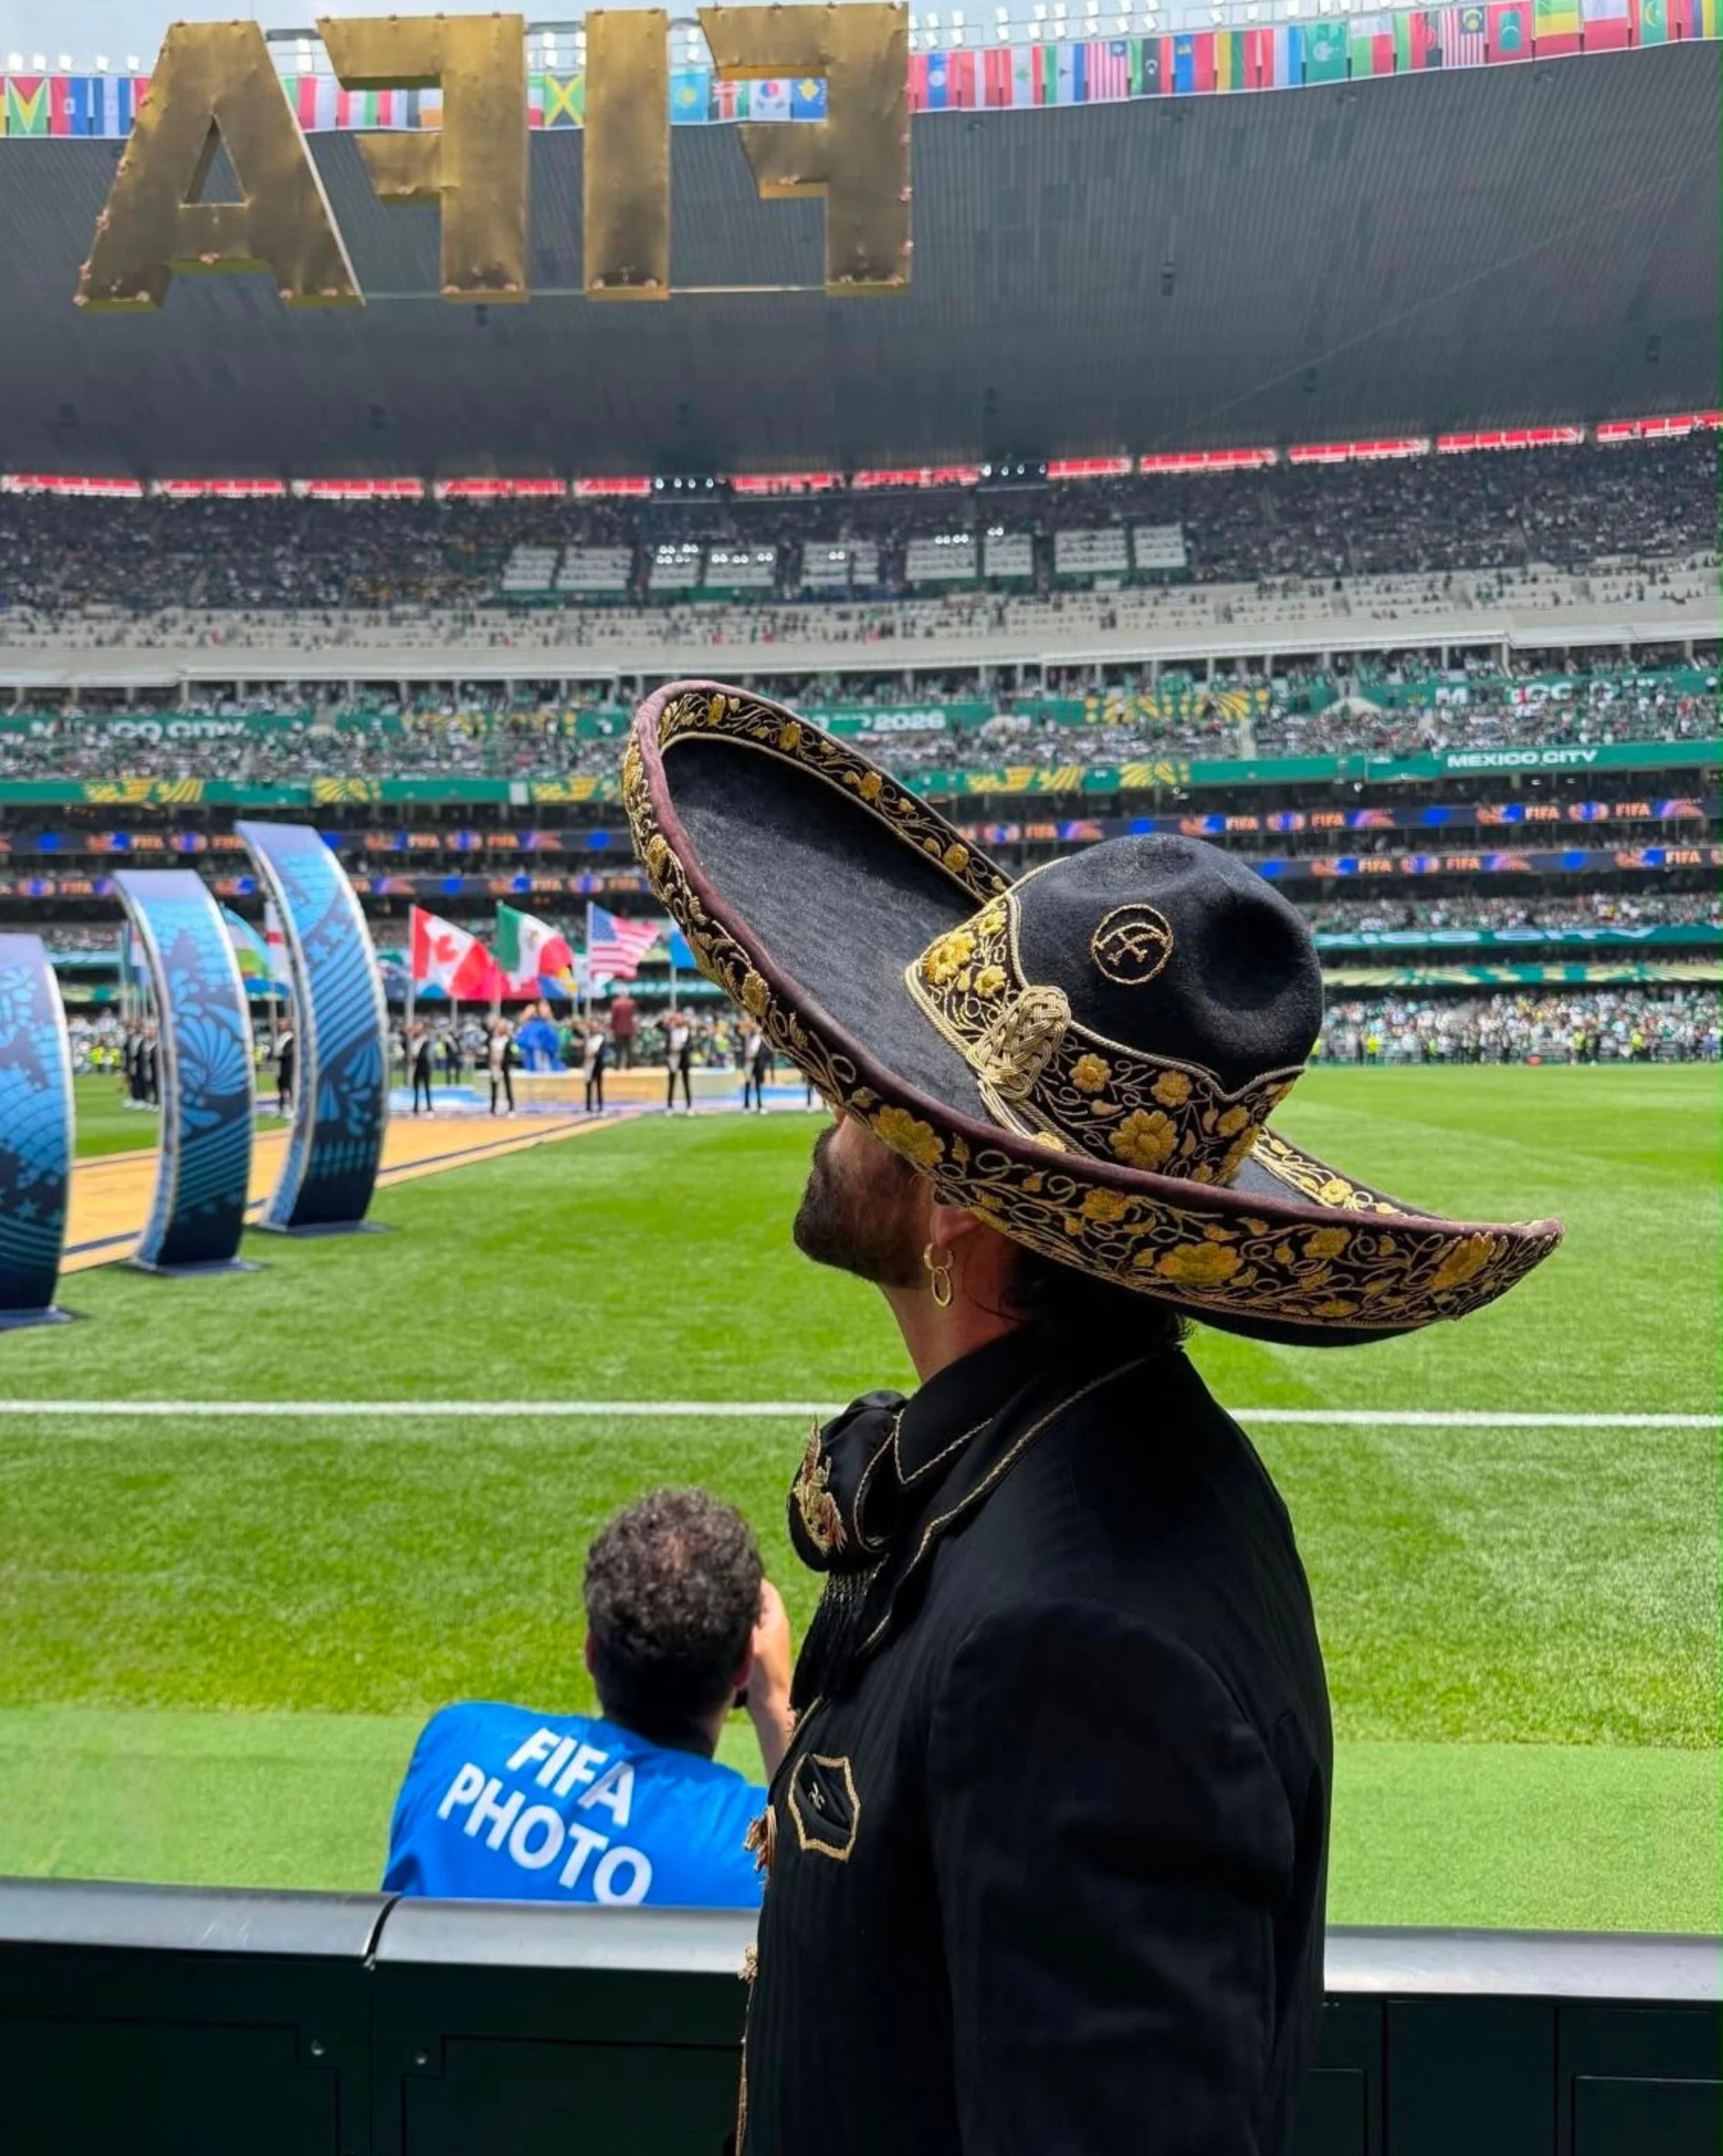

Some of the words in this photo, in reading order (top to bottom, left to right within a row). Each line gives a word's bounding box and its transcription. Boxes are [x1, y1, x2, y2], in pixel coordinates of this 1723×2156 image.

[873, 709, 946, 731] 2026
[1448, 751, 1538, 768] MEXICO
[1542, 749, 1598, 764] CITY
[1525, 805, 1560, 821] FIFA
[1615, 802, 1651, 817] FIFA
[1311, 812, 1345, 827] FIFA
[1358, 855, 1391, 873] FIFA
[1447, 856, 1480, 871] FIFA
[1665, 849, 1701, 865] FIFA
[506, 1728, 635, 1828] FIFA
[436, 1762, 653, 1905] PHOTO
